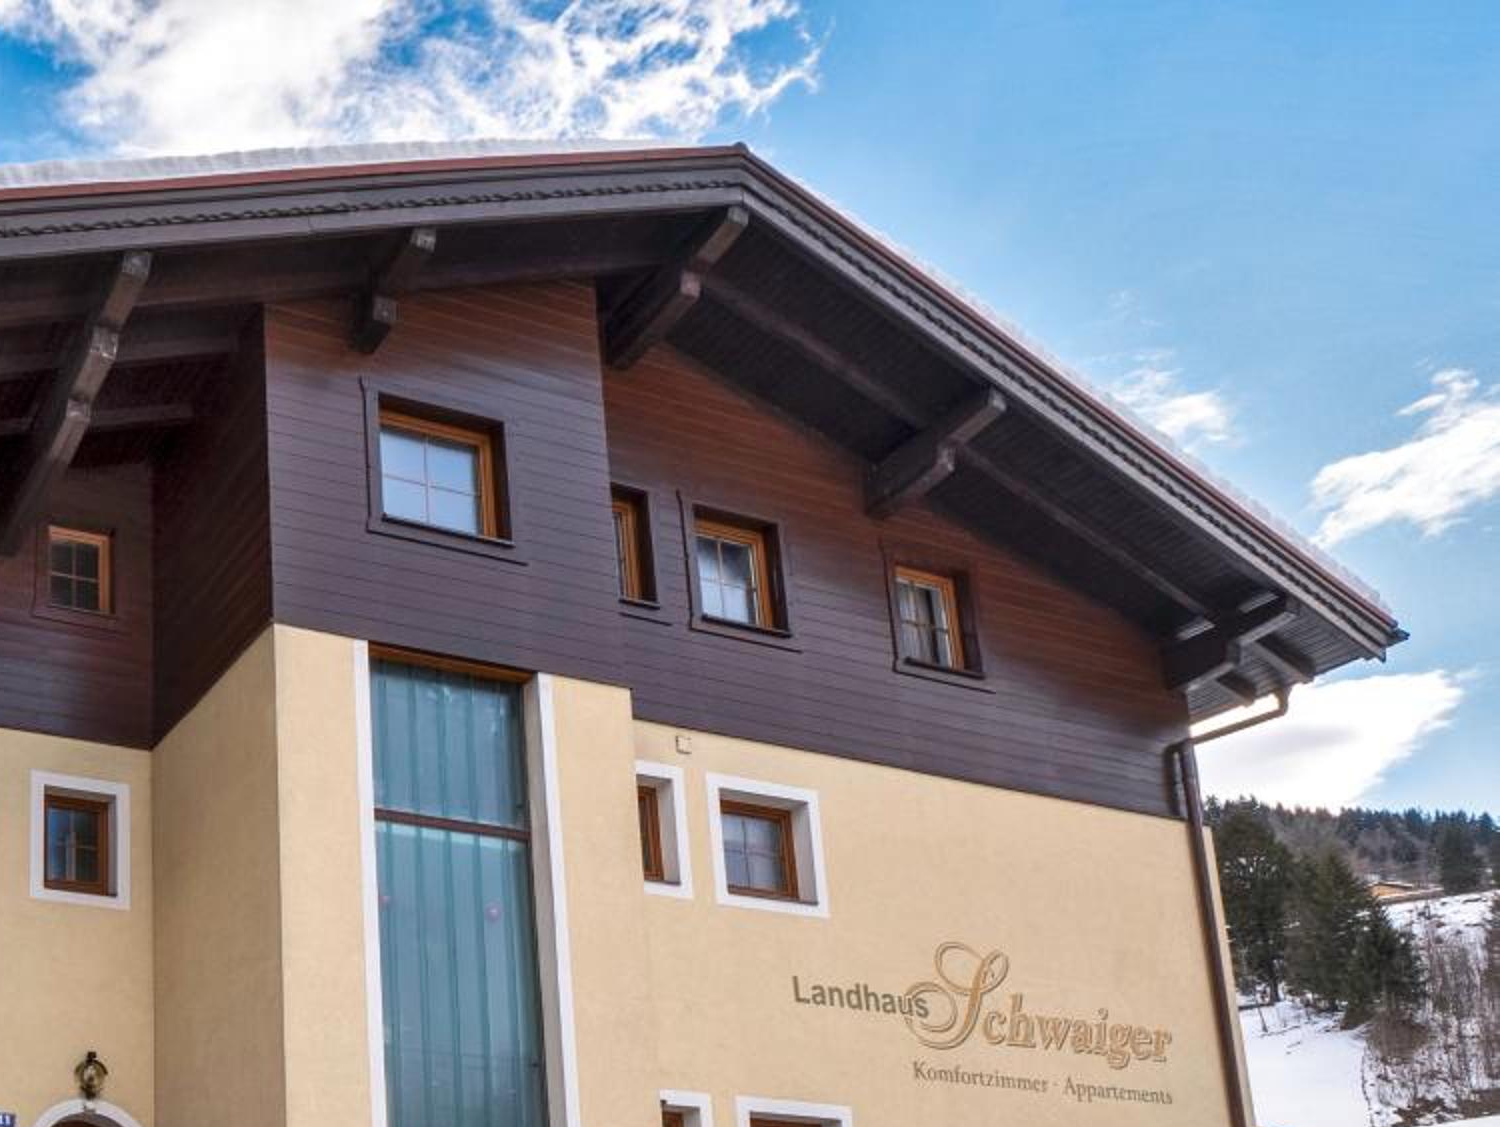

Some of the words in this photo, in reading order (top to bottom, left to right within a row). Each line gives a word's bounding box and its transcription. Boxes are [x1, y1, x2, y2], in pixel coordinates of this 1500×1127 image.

[792, 975, 930, 1019] Landhaus
[904, 941, 1173, 1070] Schwaiger
[913, 1059, 1049, 1094] Komfortzimmer
[1062, 1076, 1174, 1105] Appartements
